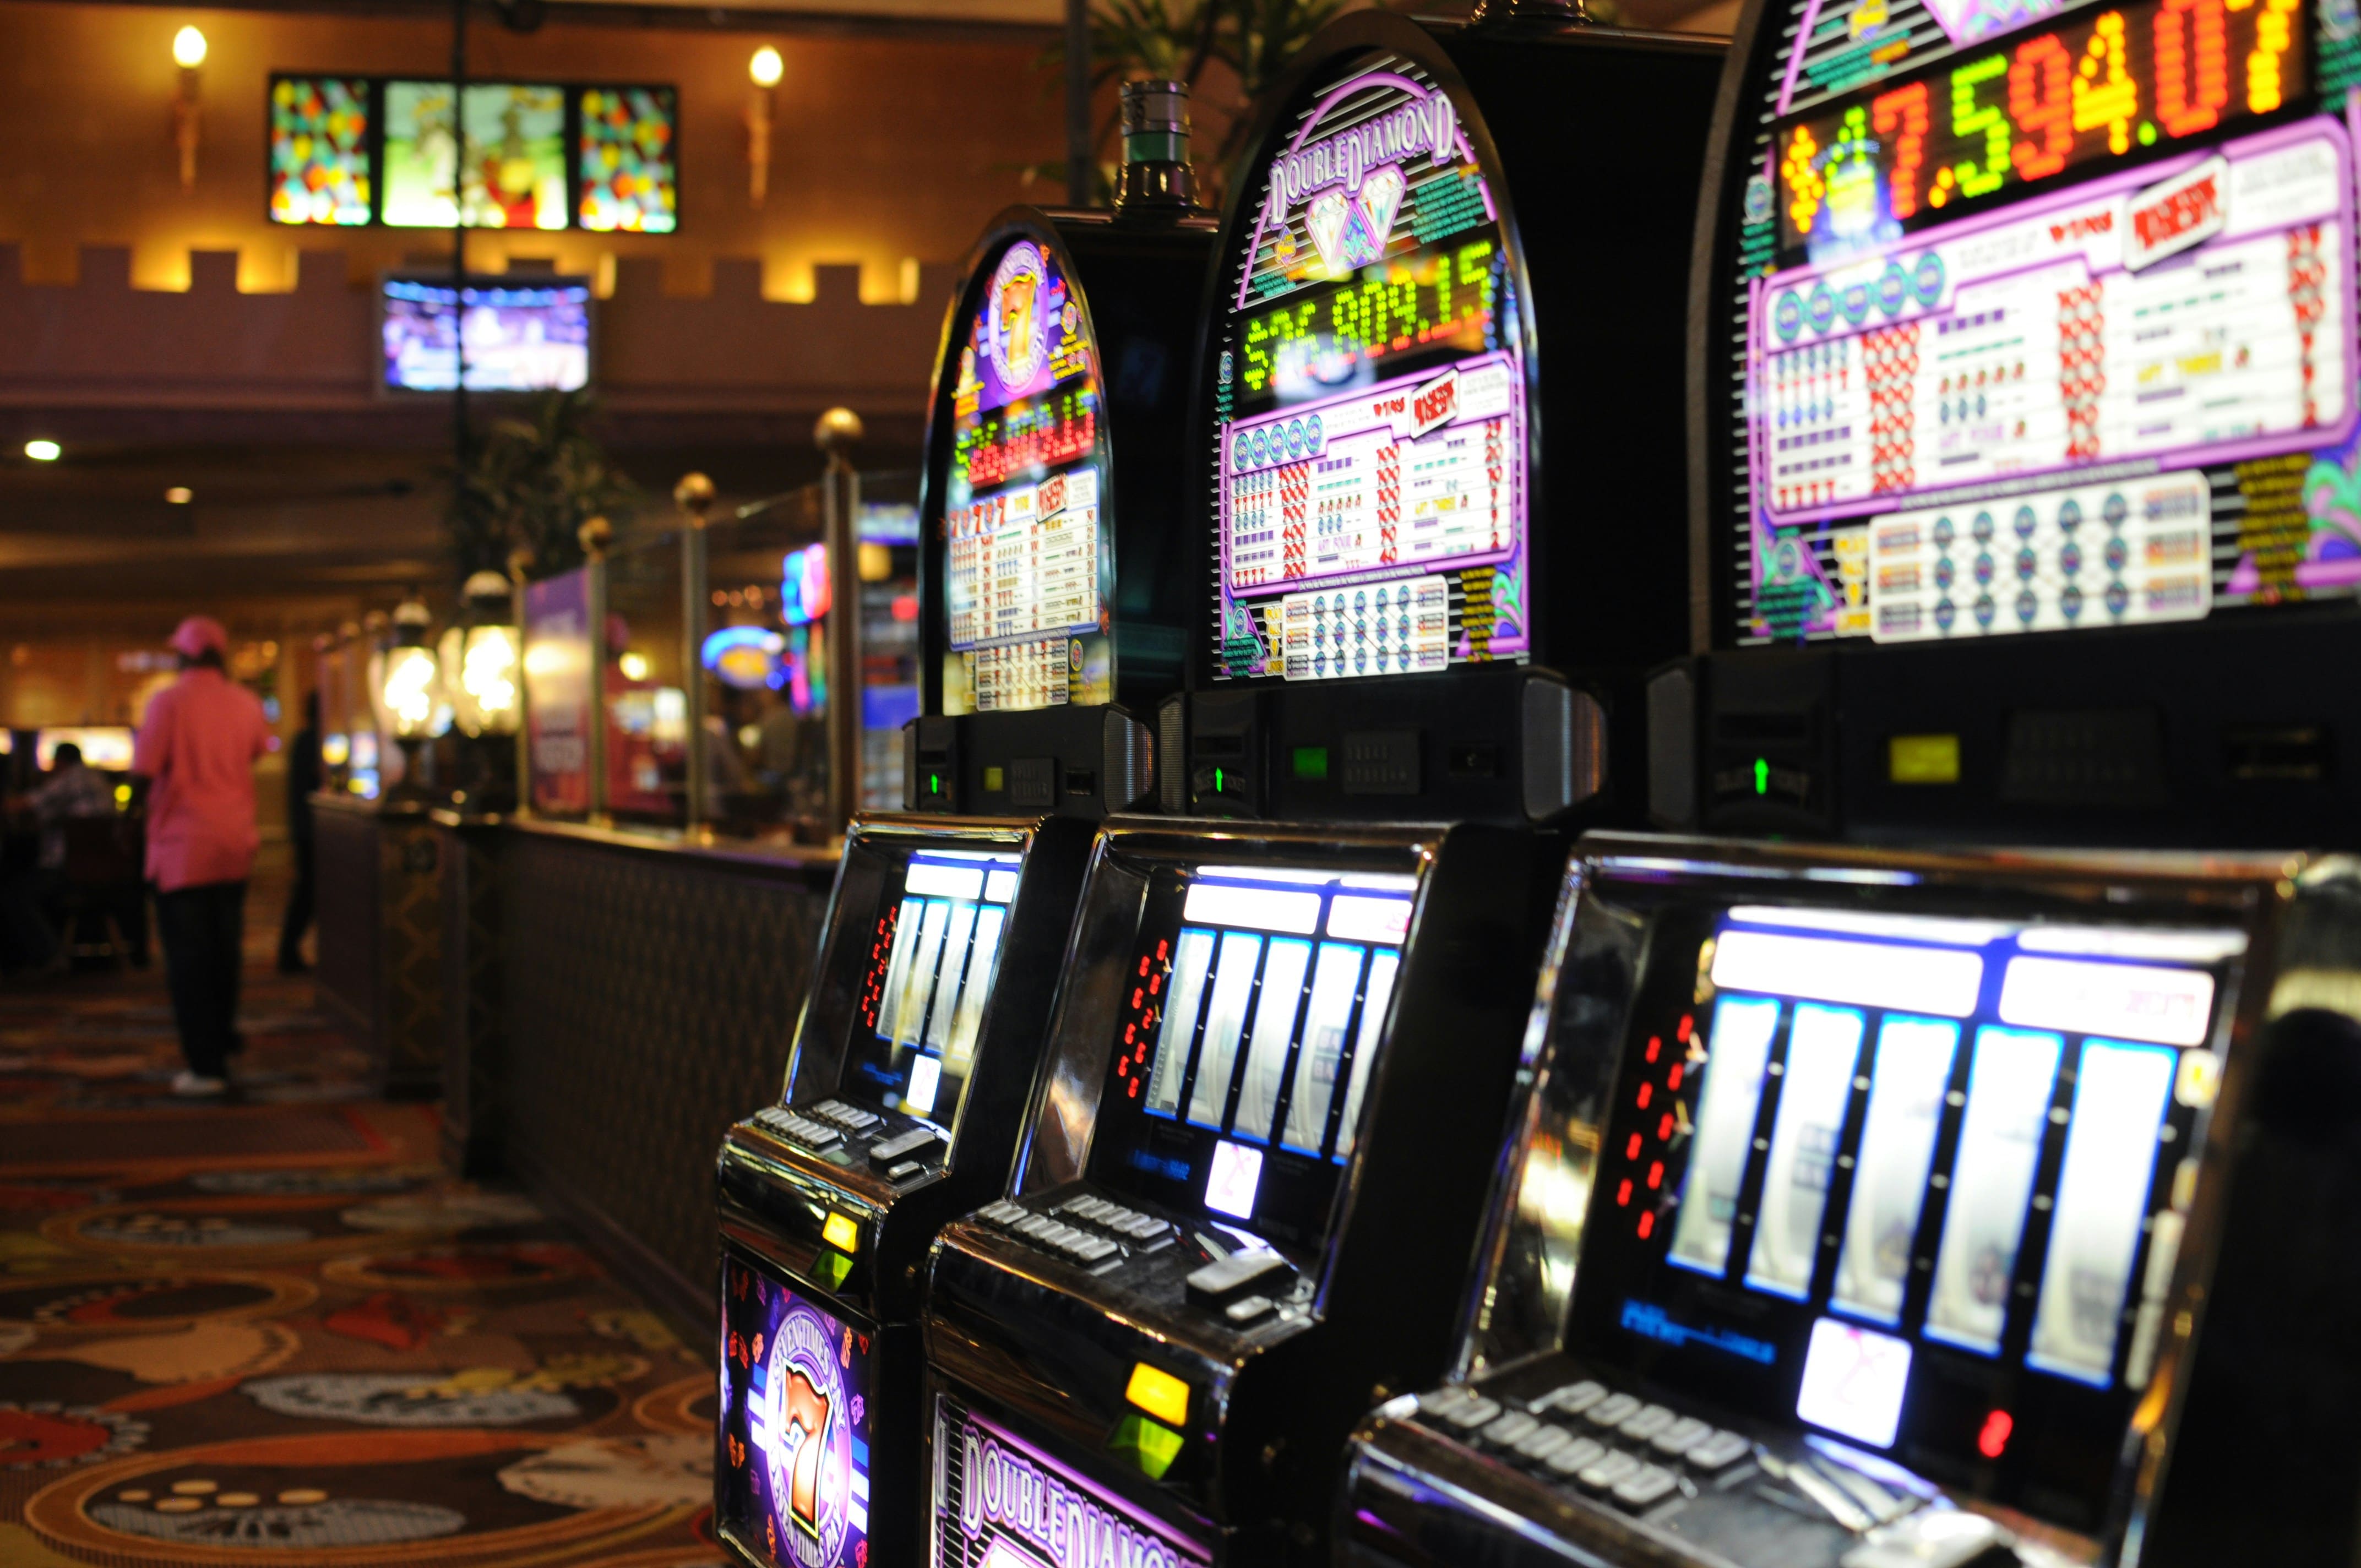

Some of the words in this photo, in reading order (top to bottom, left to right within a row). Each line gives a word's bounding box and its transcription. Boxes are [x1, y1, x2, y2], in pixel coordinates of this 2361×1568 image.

[1270, 138, 1347, 226] DOUBLE
[1347, 91, 1455, 194] DIAMOND
[782, 1357, 834, 1540] 7
[961, 1430, 1066, 1560] DOUBLE
